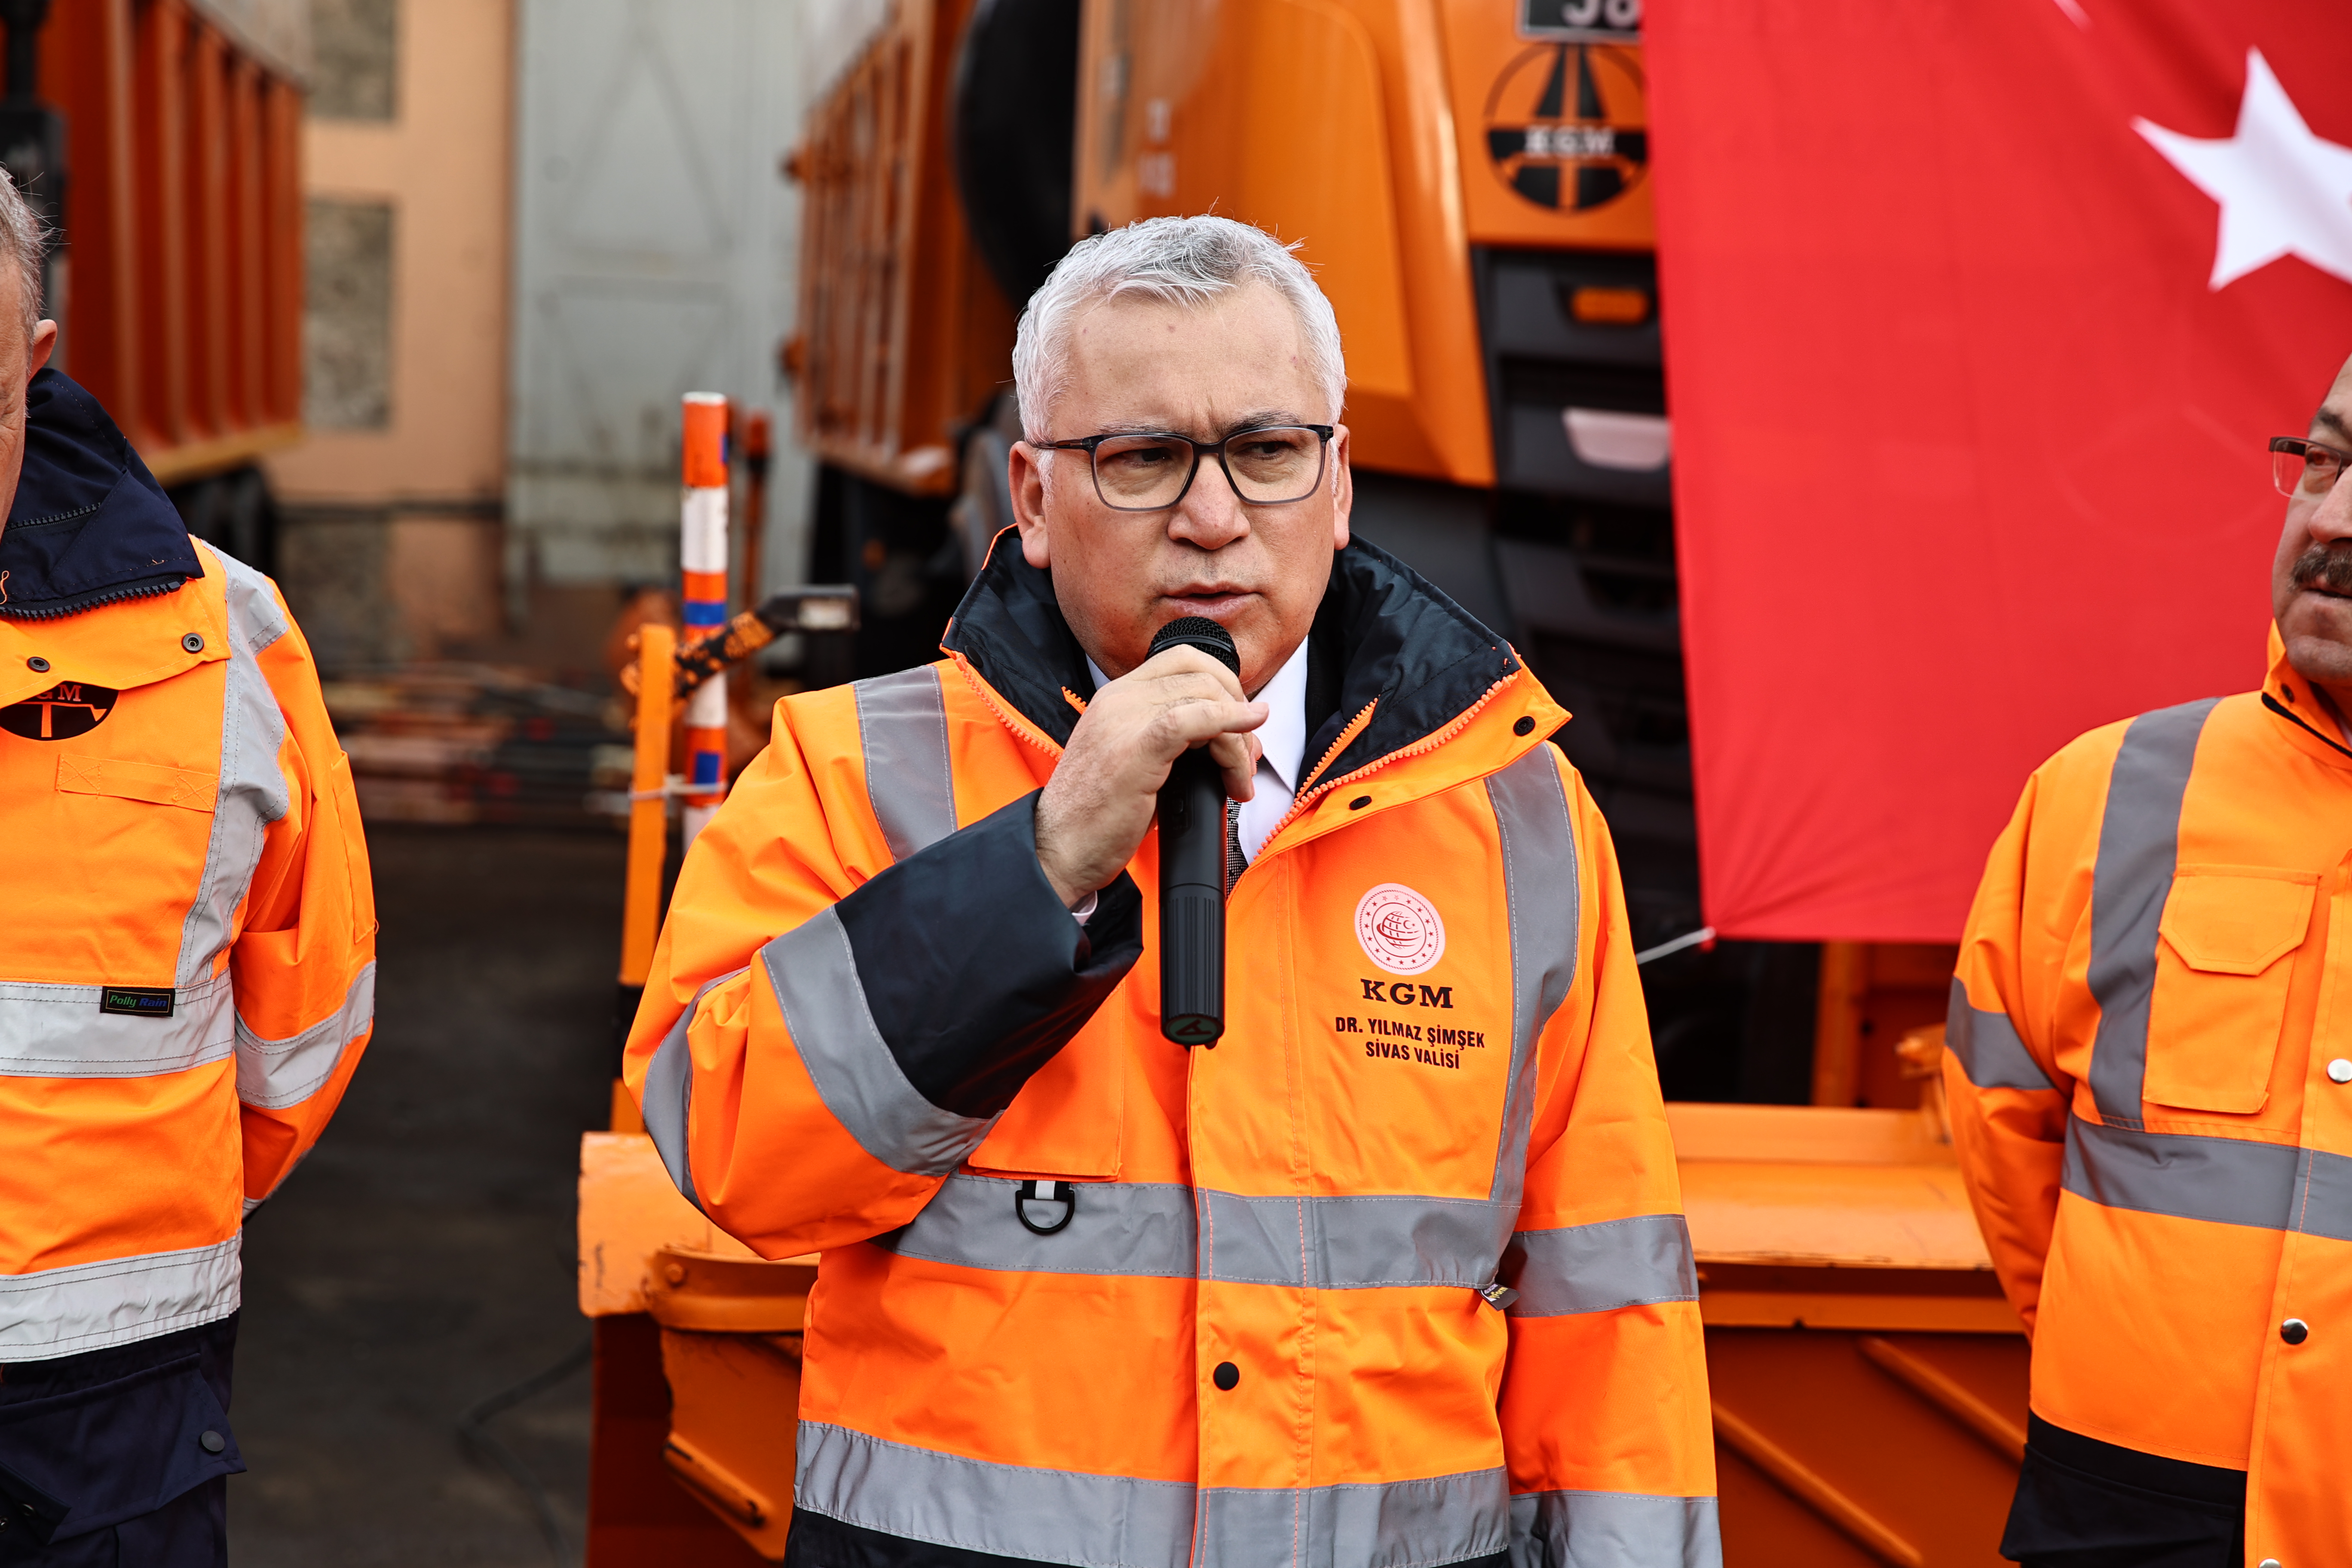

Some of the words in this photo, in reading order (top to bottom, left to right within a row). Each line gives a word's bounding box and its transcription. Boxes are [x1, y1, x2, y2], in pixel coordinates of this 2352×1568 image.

[109, 995, 137, 1008] Polly
[139, 998, 167, 1007] Rain
[1360, 978, 1454, 1009] KGM
[1335, 1017, 1363, 1032] DR.
[1368, 1018, 1422, 1041] YILMAZ
[1427, 1024, 1485, 1050] ŞİMŞEK
[1366, 1038, 1410, 1060] SİVAS
[1414, 1046, 1459, 1069] VALİSİ
